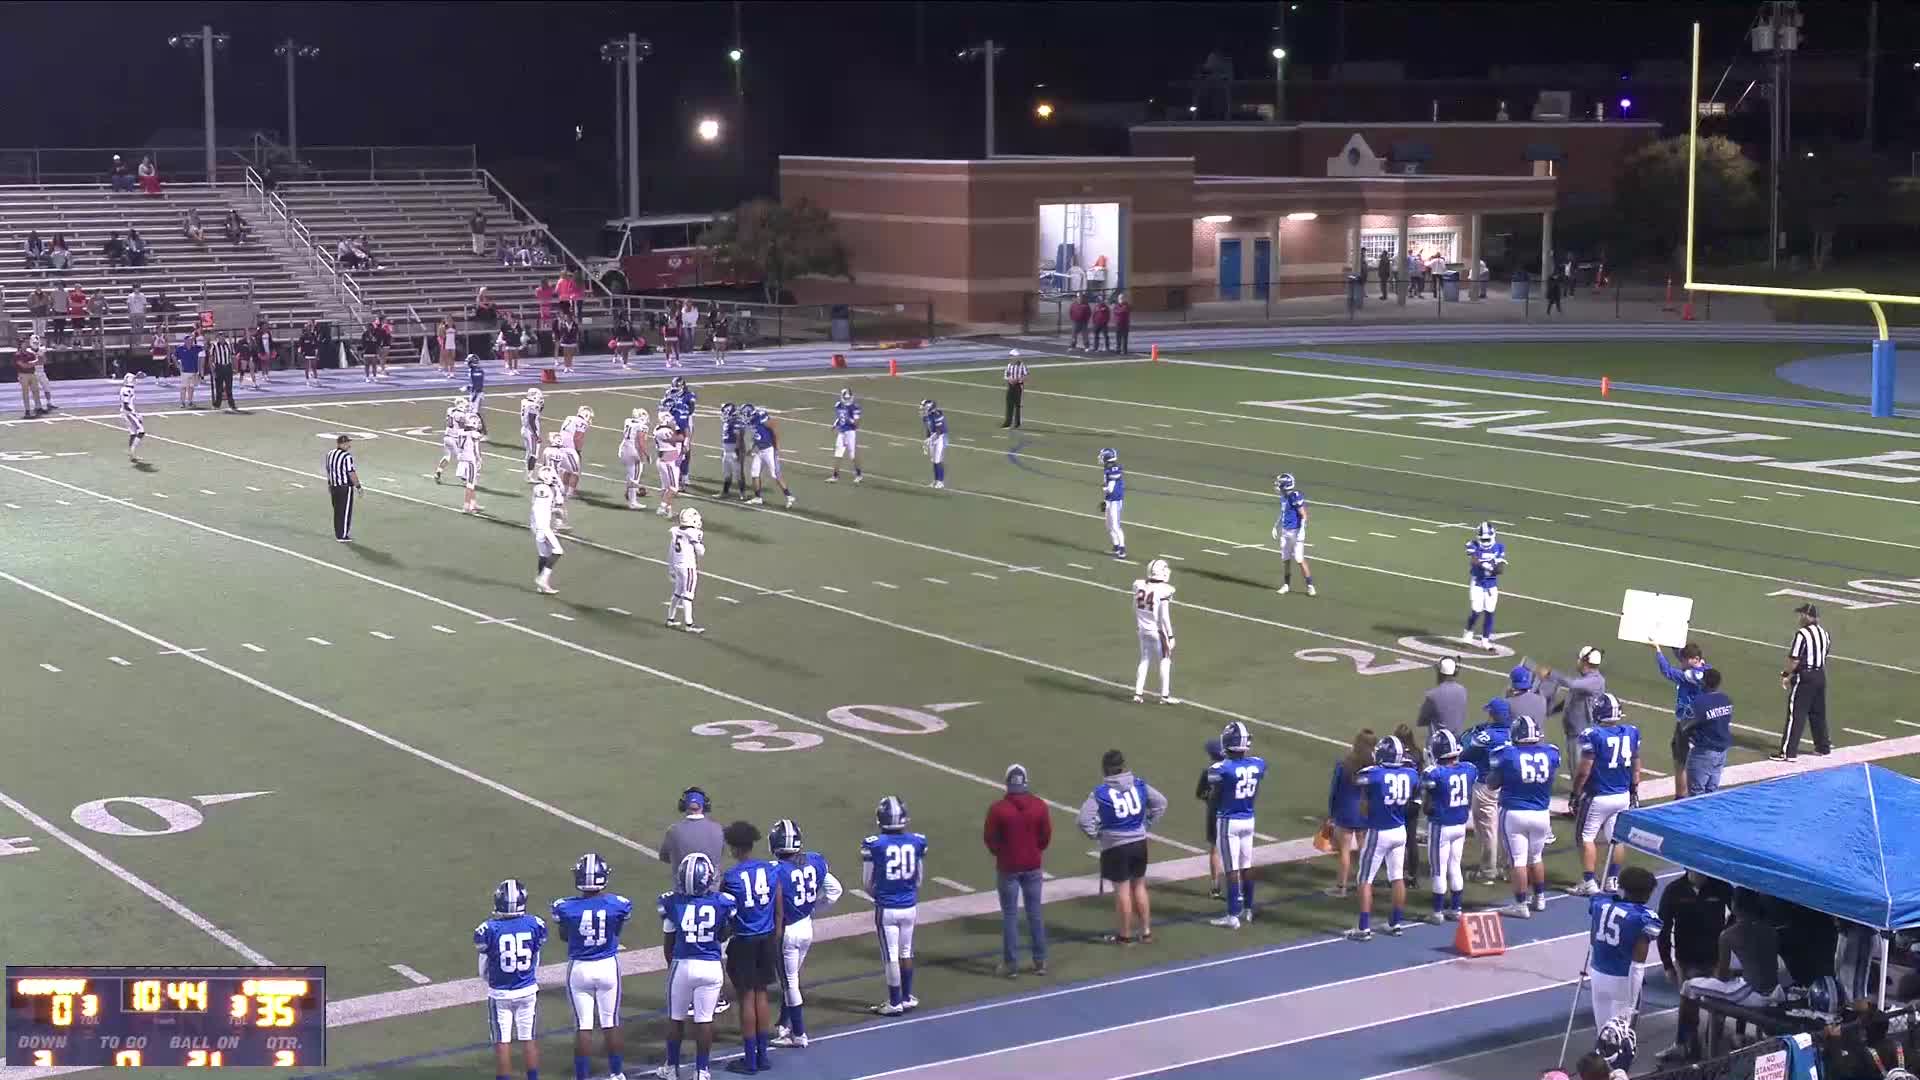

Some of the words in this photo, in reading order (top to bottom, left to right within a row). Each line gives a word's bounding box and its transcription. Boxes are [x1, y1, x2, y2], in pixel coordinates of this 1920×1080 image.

[675, 535, 683, 553] 5
[1136, 589, 1155, 612] 24
[1294, 635, 1516, 675] 20
[691, 704, 950, 752] 30
[1520, 752, 1550, 784] 63
[1607, 735, 1632, 769] 74
[1235, 763, 1260, 800] 26
[1384, 773, 1410, 806] 30
[1449, 773, 1469, 808] 21
[886, 843, 916, 880] 20
[740, 867, 770, 908] 14
[790, 865, 818, 907] 33
[578, 909, 608, 946] 41
[681, 904, 716, 943] 42
[1467, 914, 1500, 949] 30
[1595, 903, 1628, 947] 15
[499, 932, 533, 973] 85
[1755, 1061, 1785, 1075] STANDING
[1766, 1054, 1776, 1063] NO
